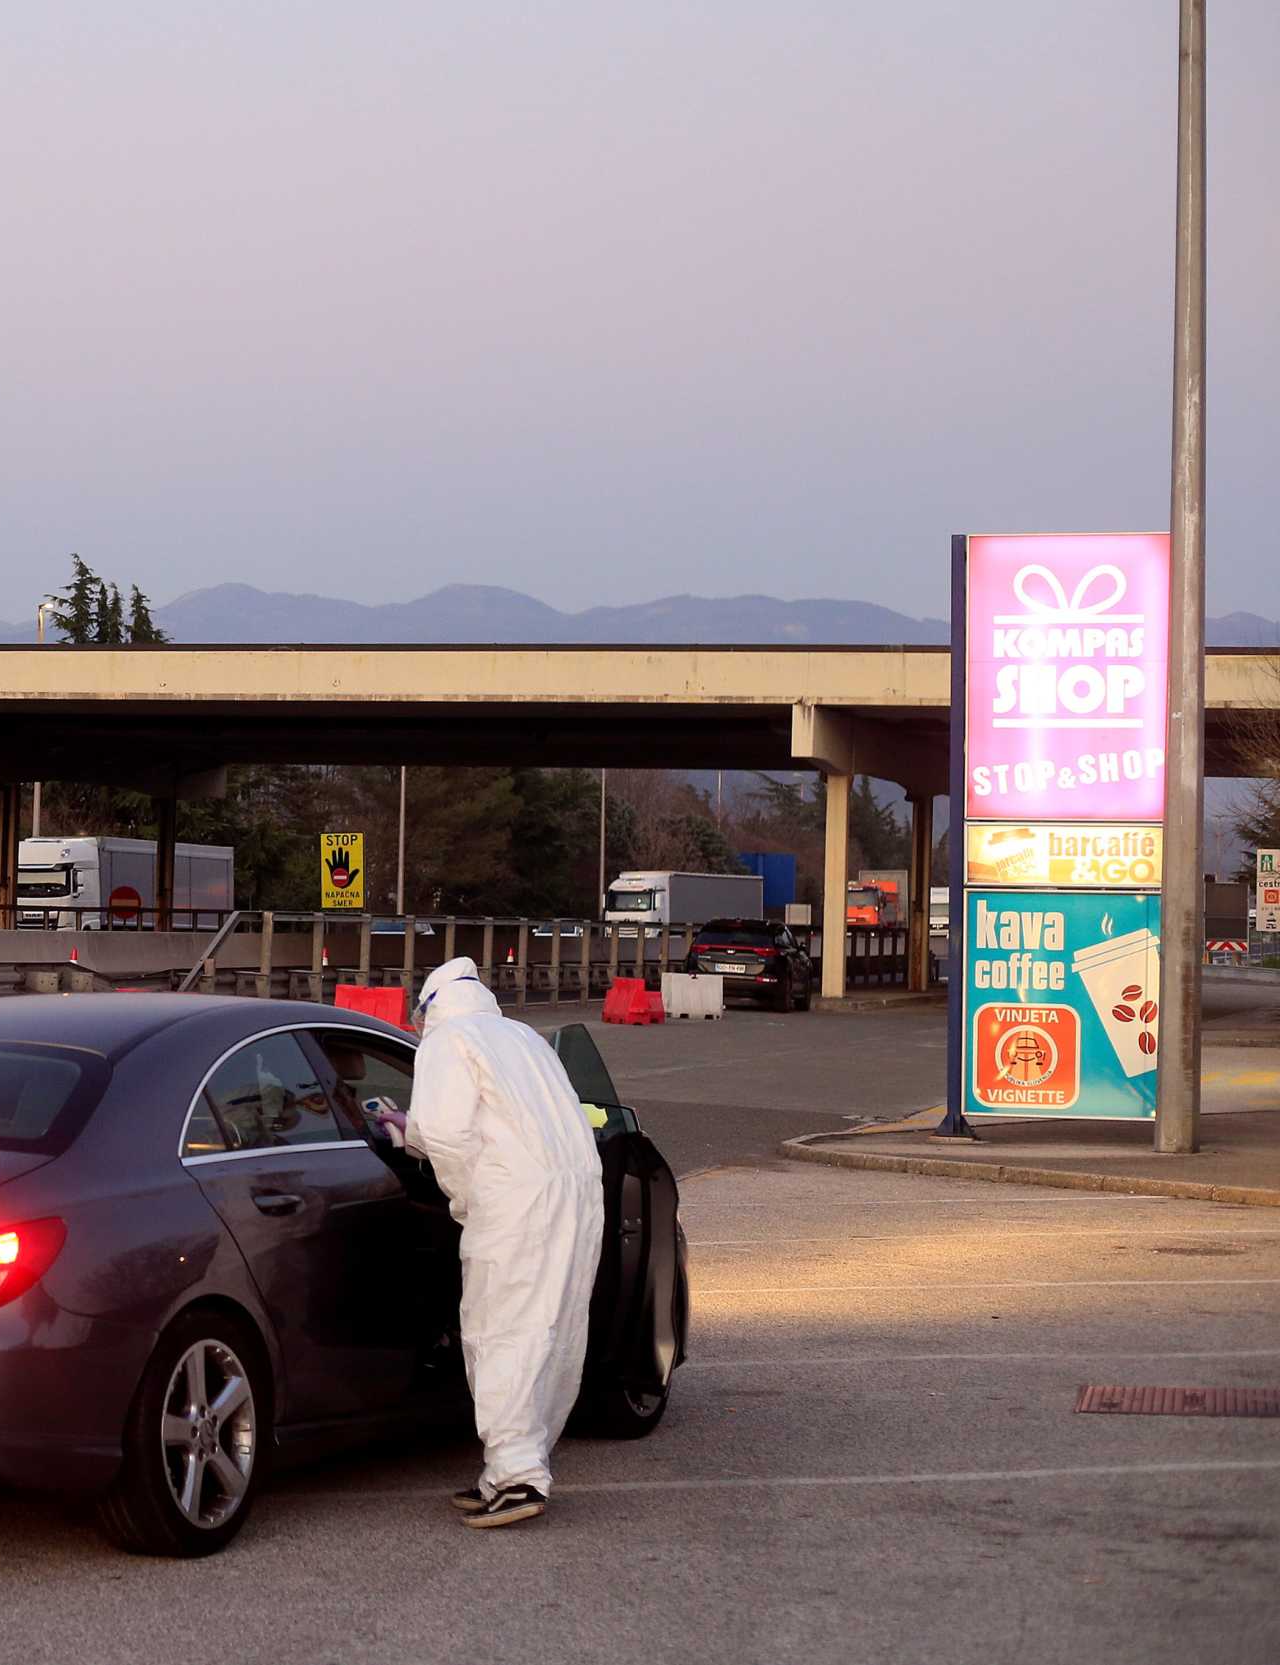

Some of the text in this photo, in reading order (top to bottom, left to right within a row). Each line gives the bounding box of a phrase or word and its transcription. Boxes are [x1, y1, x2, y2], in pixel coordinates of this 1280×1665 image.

[992, 627, 1145, 657] KOMPAS
[992, 664, 1146, 714] SHOP
[326, 834, 358, 847] STOP
[333, 899, 353, 907] SMER
[976, 899, 1065, 951] kava
[975, 952, 1065, 990] coffee
[994, 1008, 1059, 1024] VINJETA
[987, 1088, 1065, 1104] VIGNETTE
